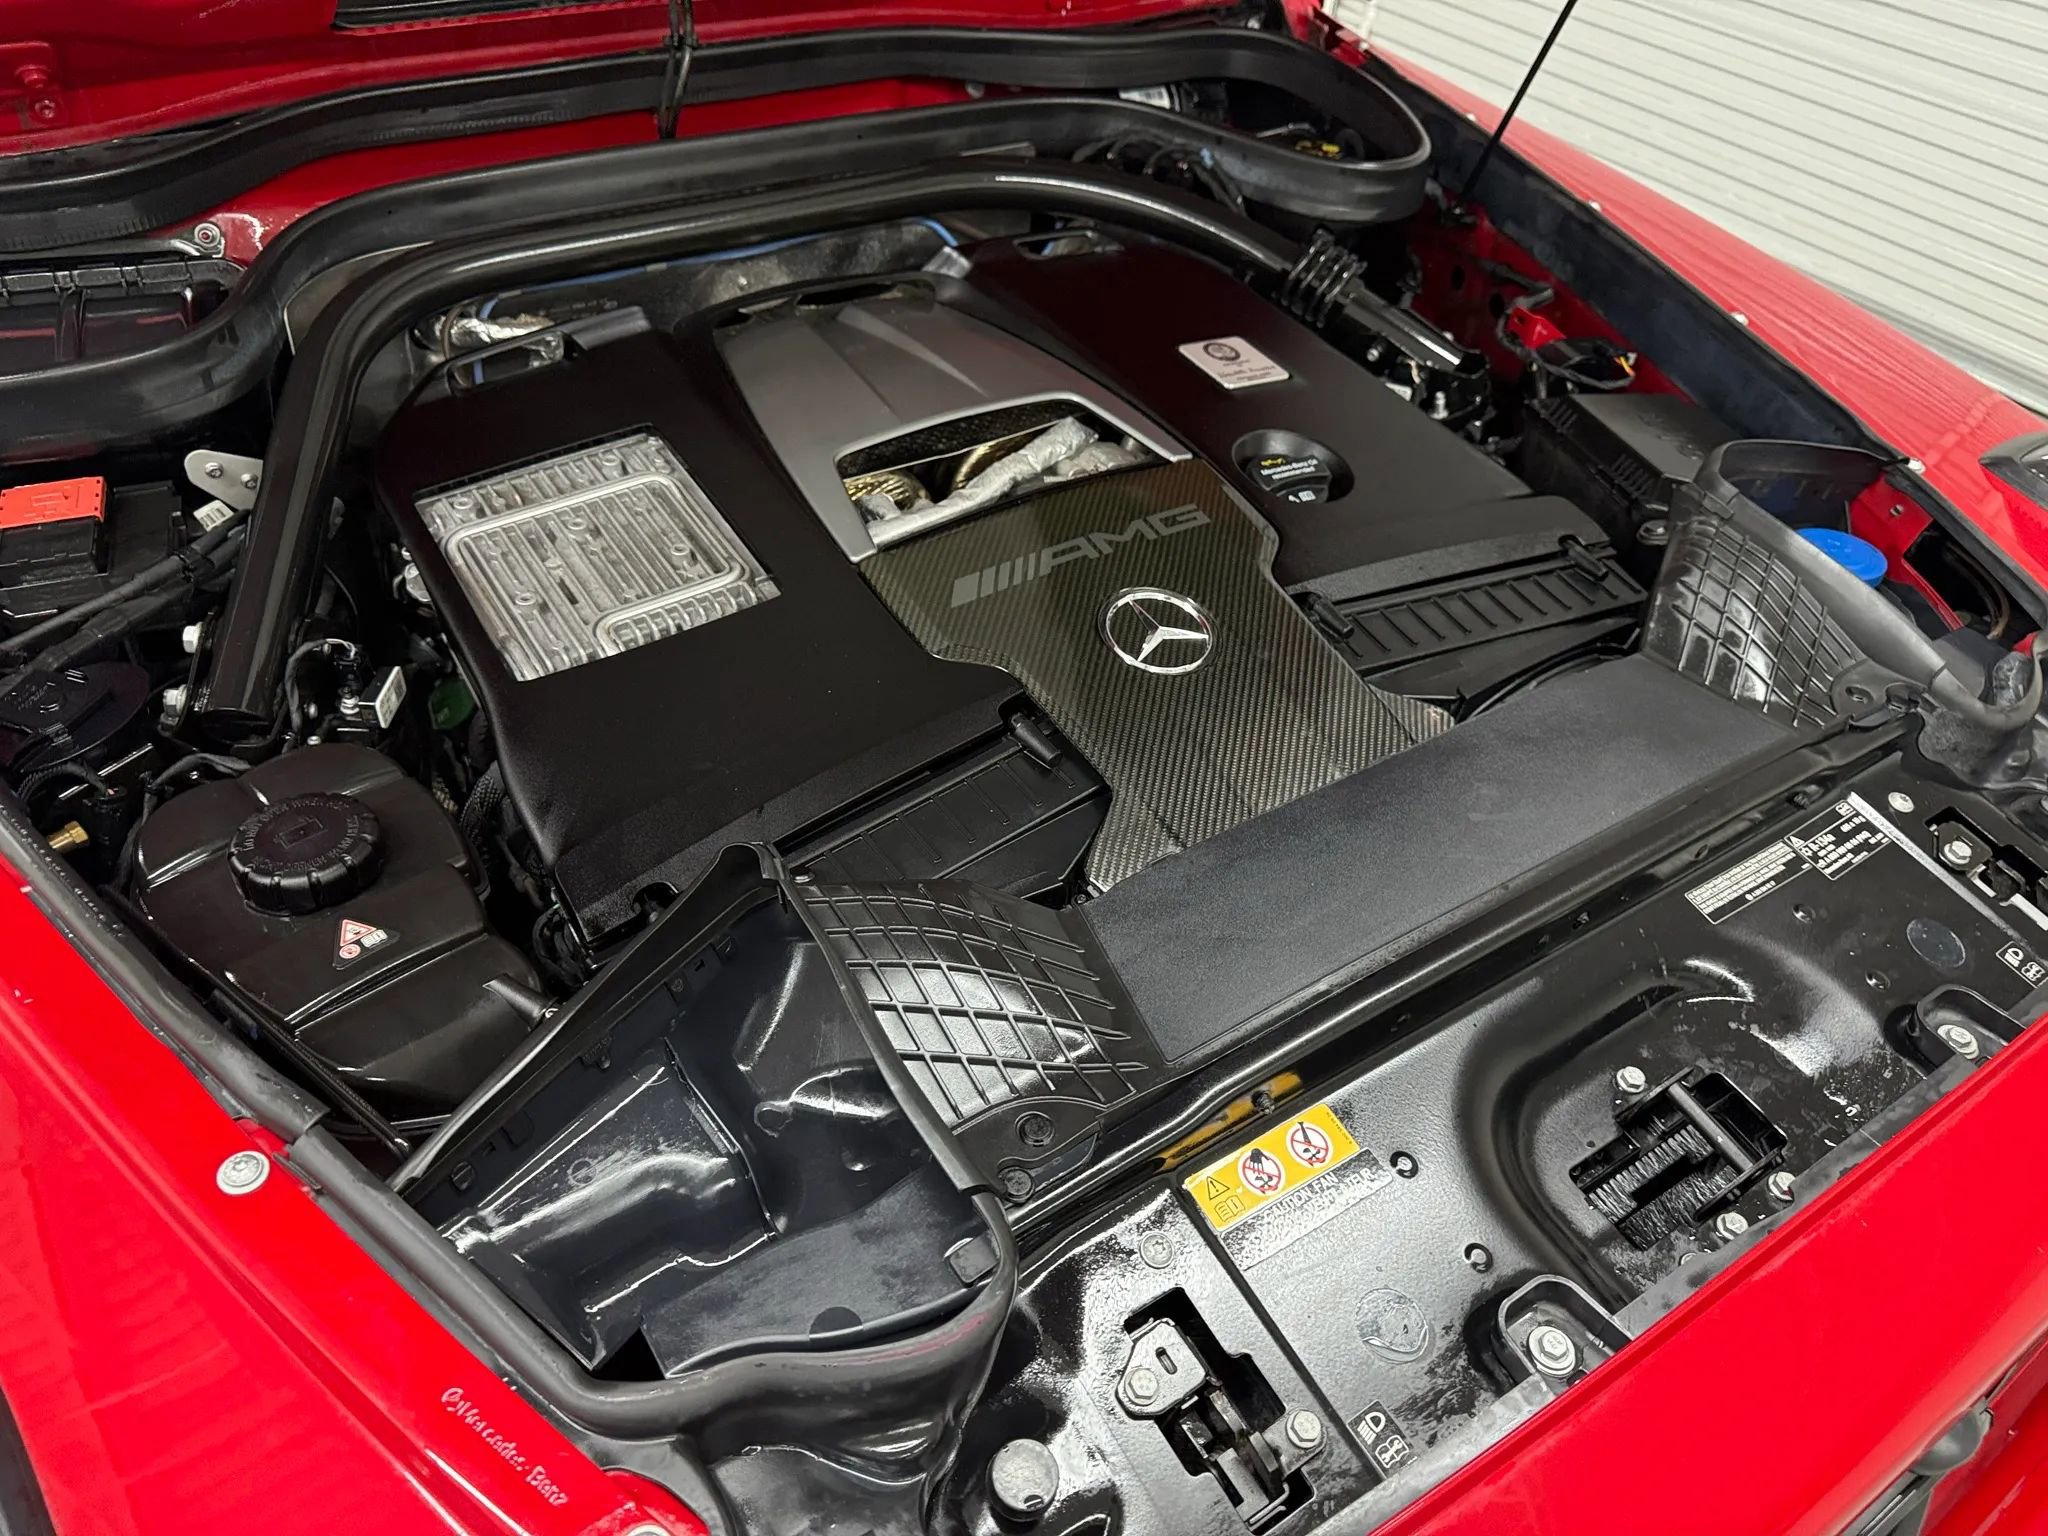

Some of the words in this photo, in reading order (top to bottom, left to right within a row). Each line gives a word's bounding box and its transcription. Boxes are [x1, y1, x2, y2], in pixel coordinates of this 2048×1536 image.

[1807, 833, 1836, 852] R-134a
[1263, 1187, 1313, 1220] CAUTION
[1311, 1171, 1339, 1198] FAN
